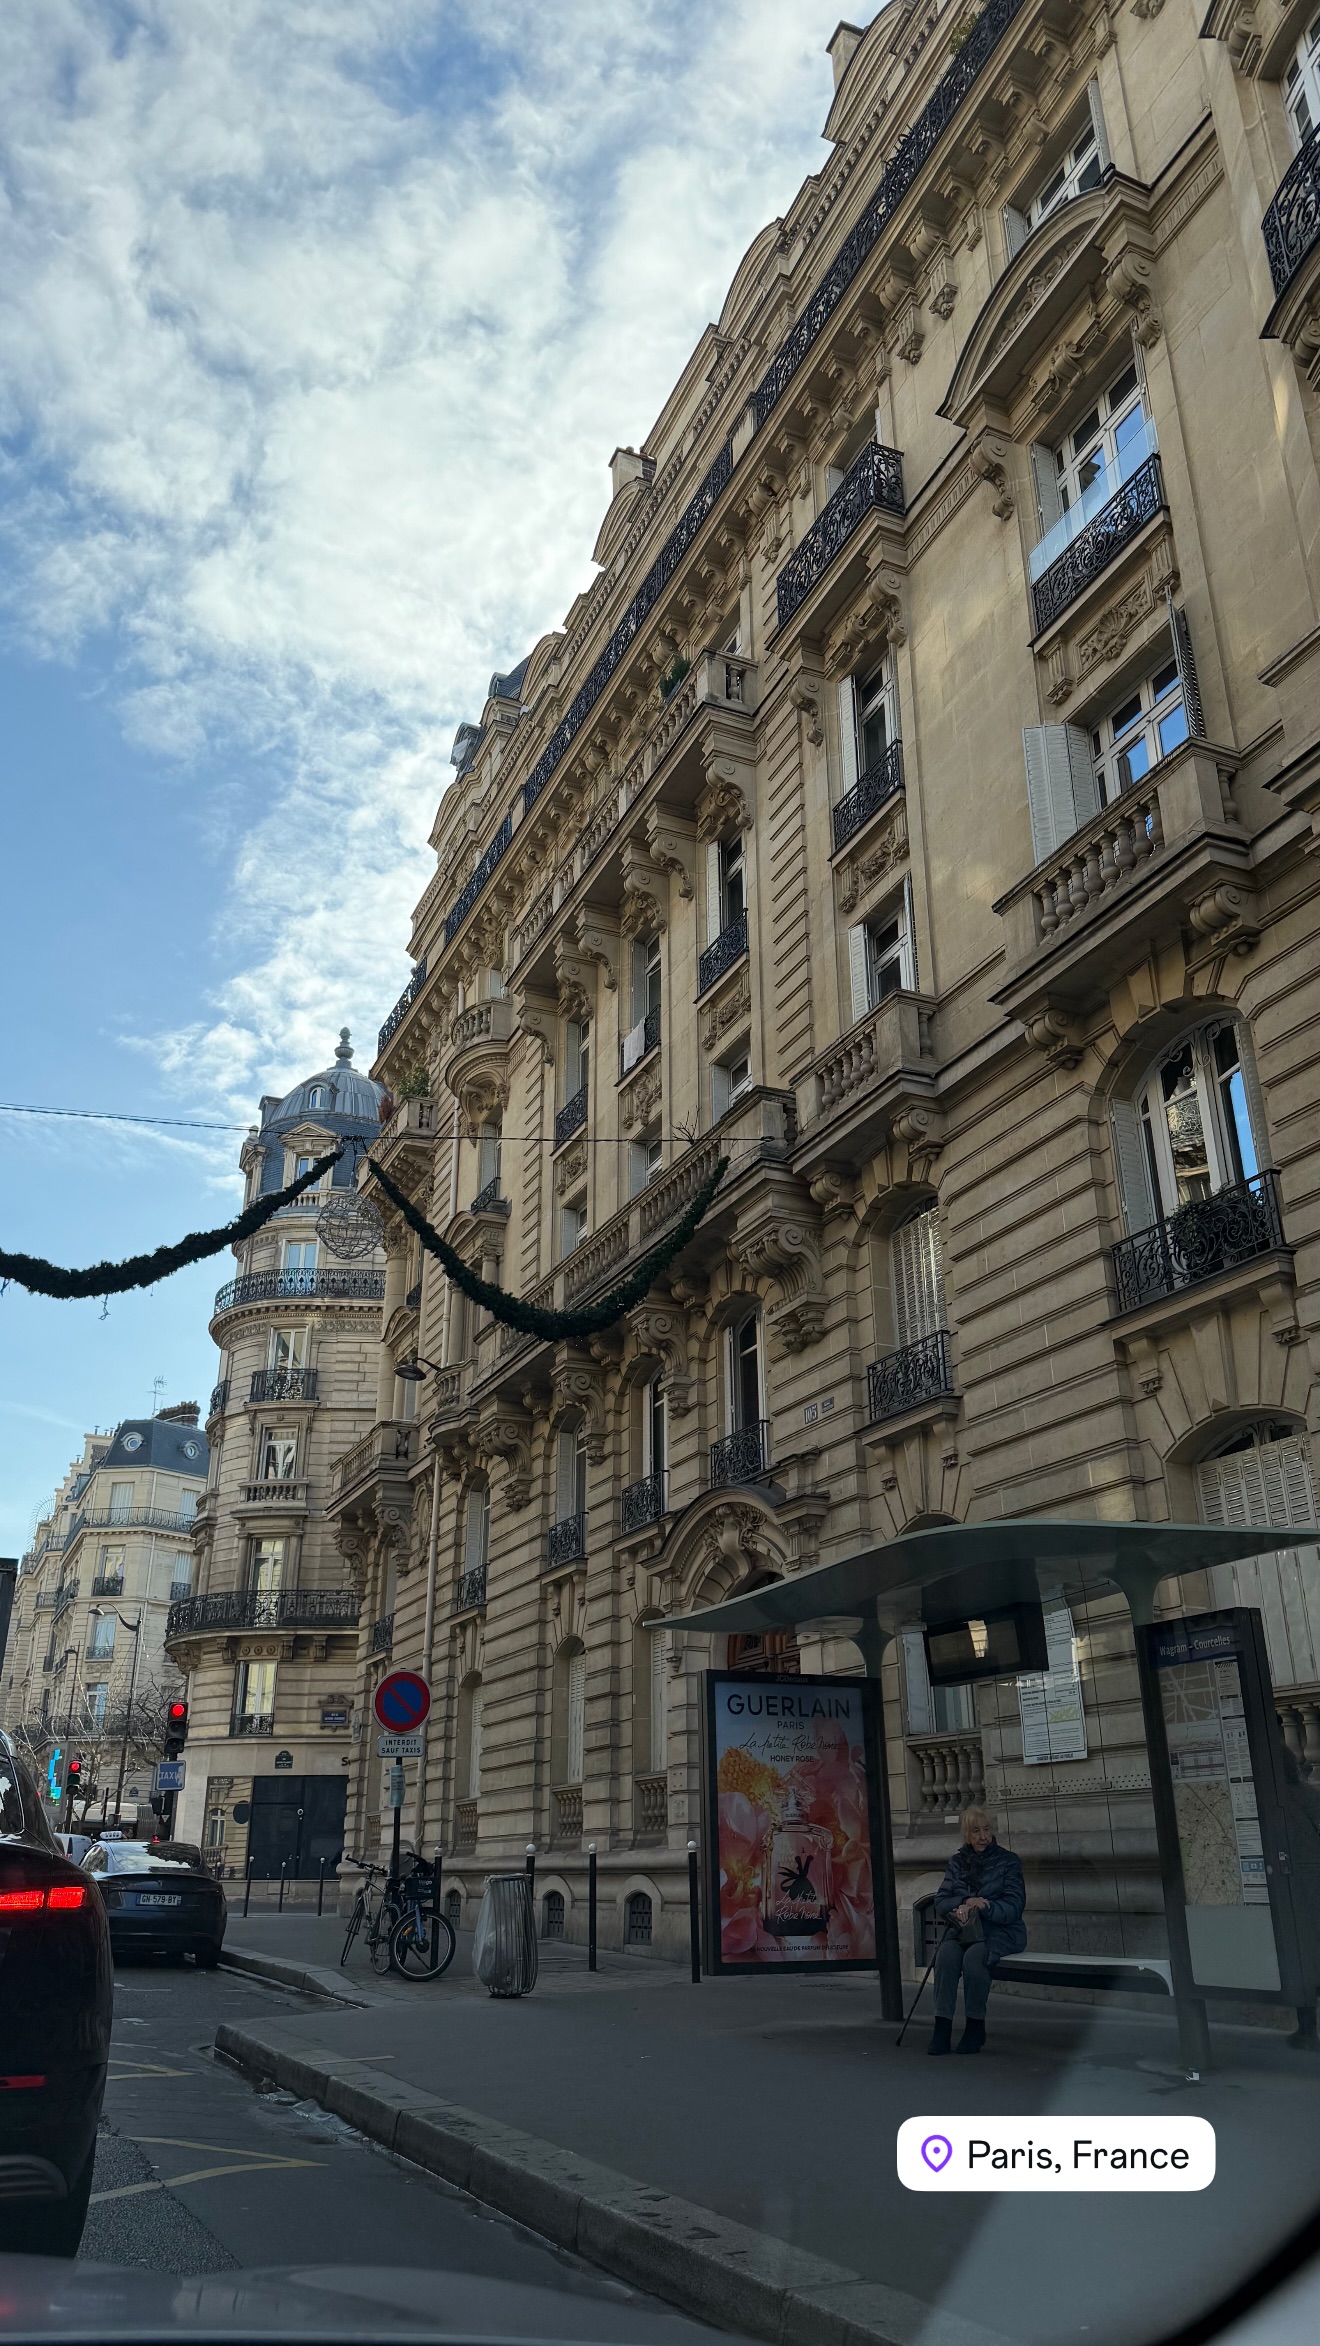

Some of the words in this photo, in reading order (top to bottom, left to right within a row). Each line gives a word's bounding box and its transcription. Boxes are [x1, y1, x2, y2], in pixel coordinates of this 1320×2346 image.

[805, 1405, 817, 1423] 105
[1159, 1643, 1188, 1657] Wagram
[1193, 1635, 1231, 1650] Courcelles
[775, 1674, 809, 1684] JCDecaux
[727, 1694, 850, 1719] GUERLAIN
[777, 1720, 805, 1730] PARIS
[770, 1755, 795, 1763] HONEY
[796, 1755, 814, 1763] ROSE
[141, 1895, 177, 1904] GN-579-BY
